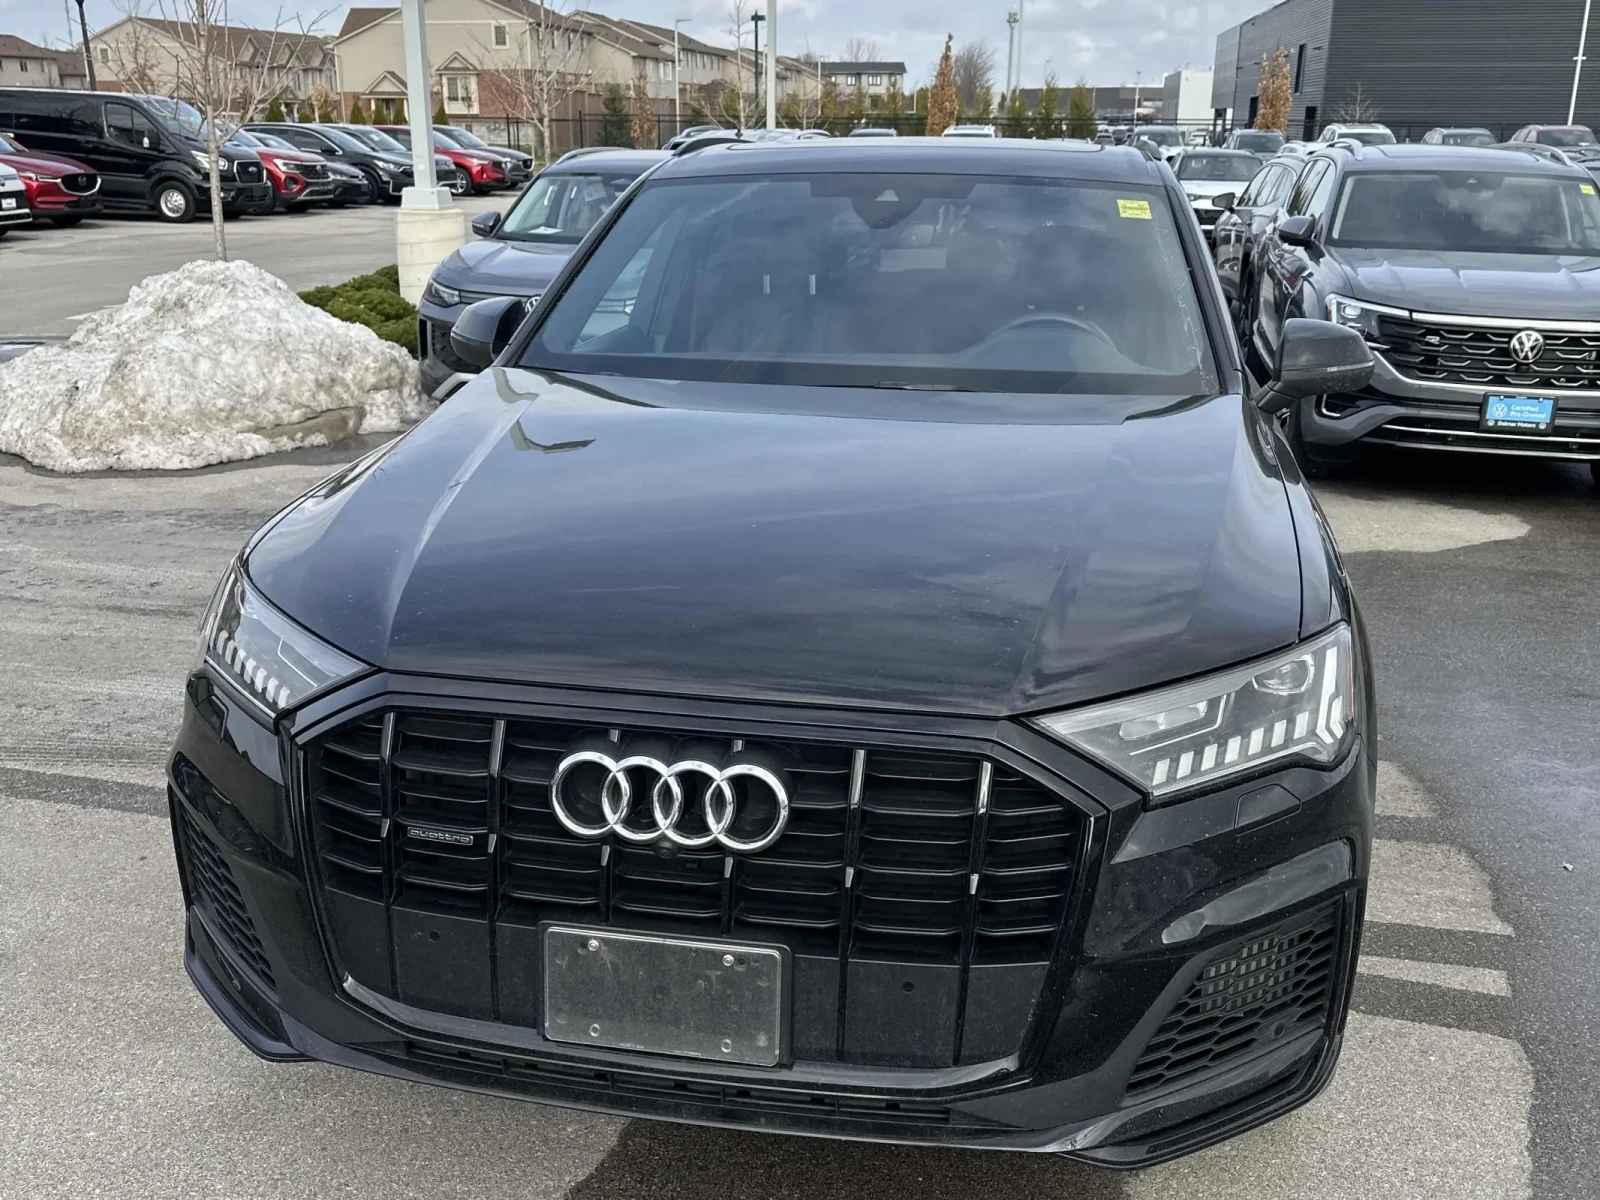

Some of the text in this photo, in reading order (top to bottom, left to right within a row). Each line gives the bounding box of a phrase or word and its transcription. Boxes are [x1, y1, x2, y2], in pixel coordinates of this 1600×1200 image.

[1511, 404, 1539, 412] Certified
[1510, 411, 1547, 419] Pre-Owned
[409, 828, 471, 844] quattro
